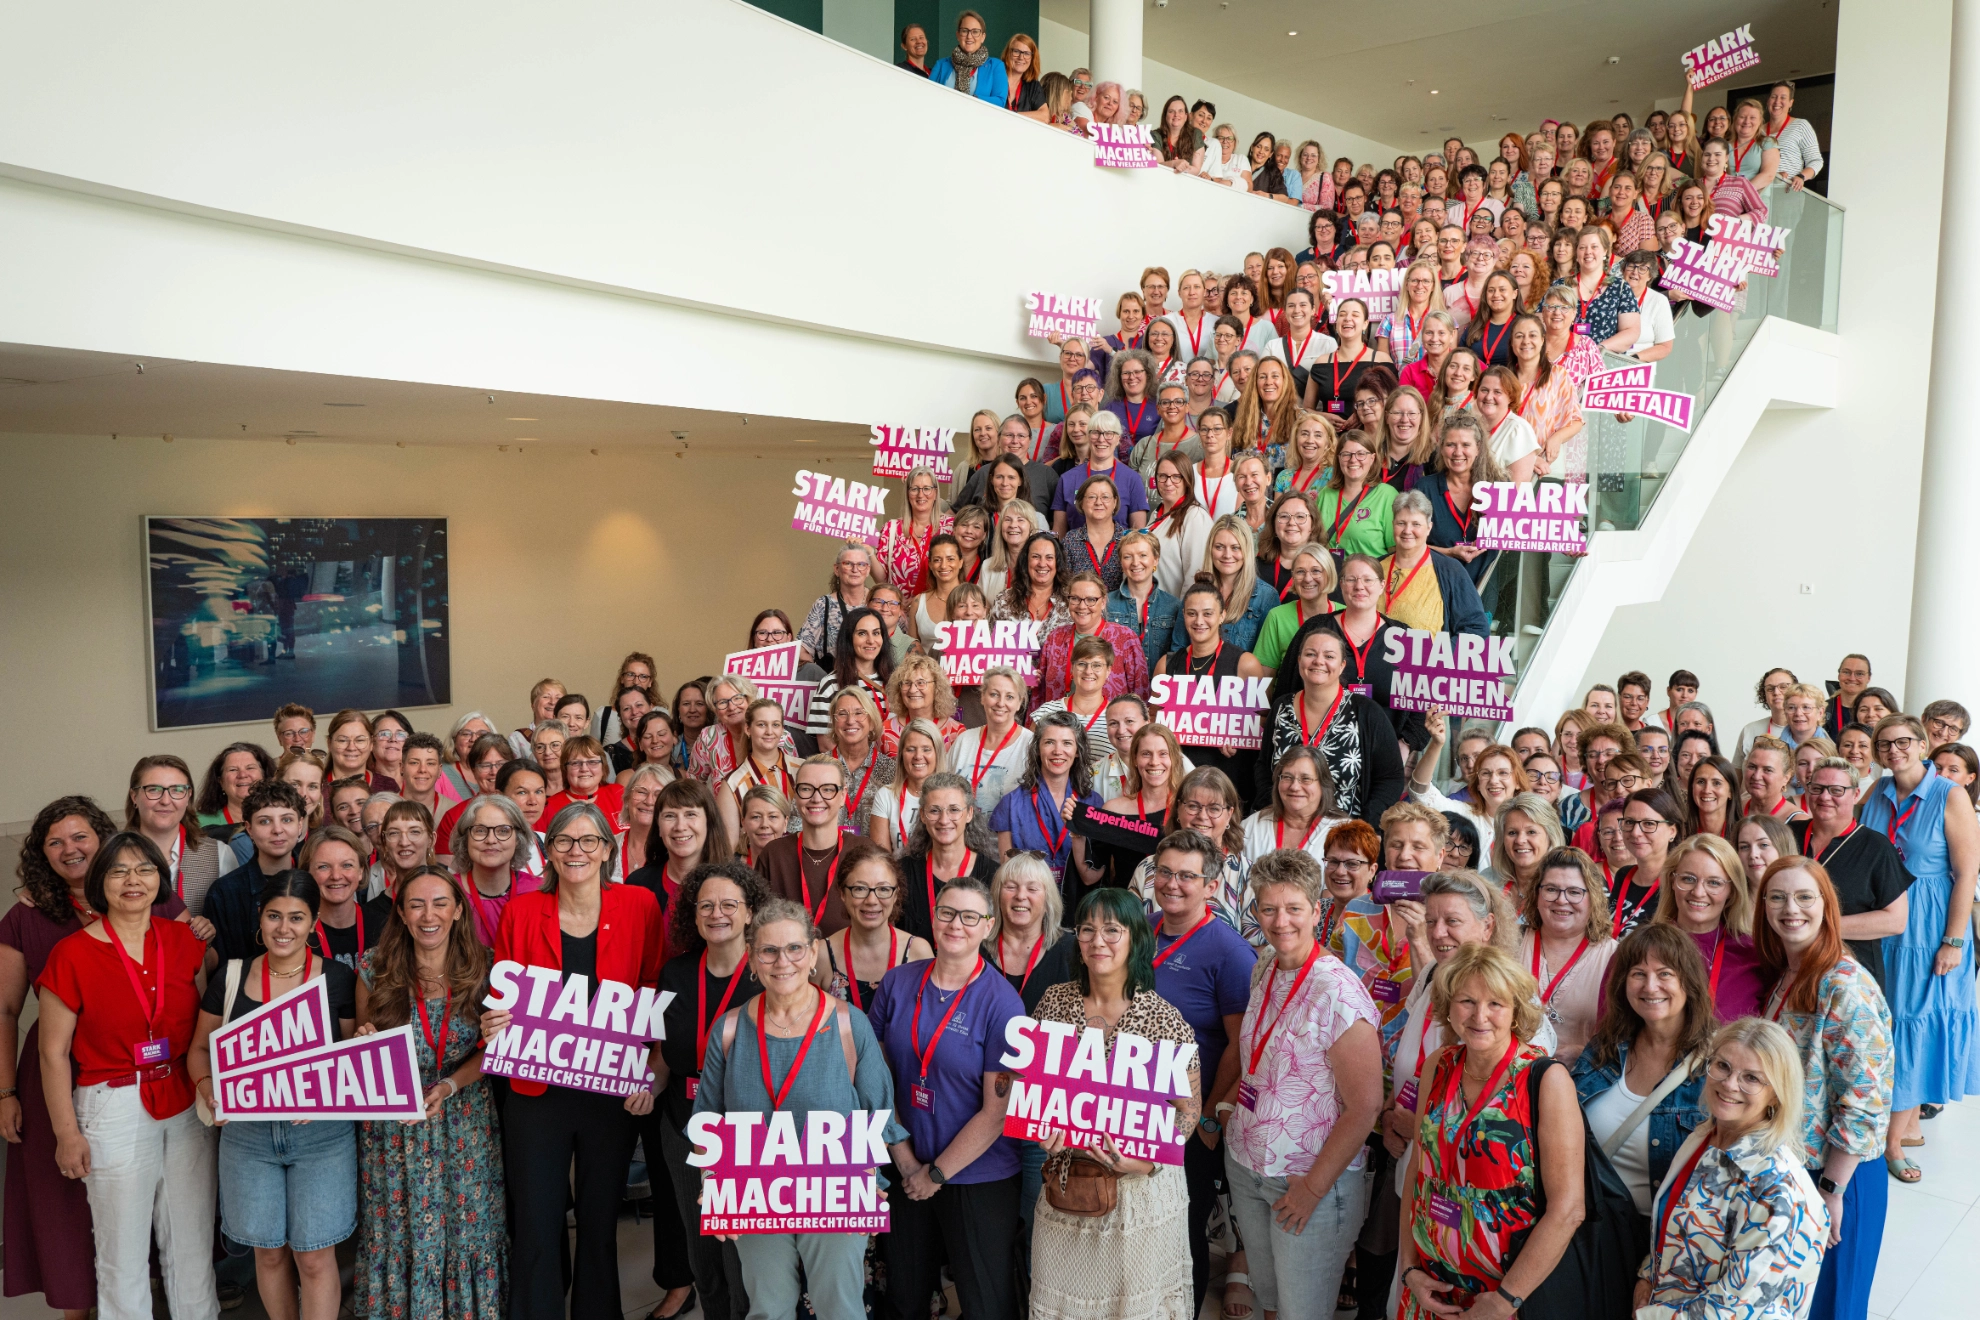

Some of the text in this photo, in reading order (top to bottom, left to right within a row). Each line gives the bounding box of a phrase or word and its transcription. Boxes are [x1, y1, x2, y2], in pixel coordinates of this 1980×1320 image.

[1681, 23, 1755, 72] STARK
[1691, 46, 1759, 85] MACHEN.
[1693, 58, 1760, 91] FÜR GLEICHSTELLUNG
[1086, 121, 1155, 145] STARK
[1095, 145, 1157, 161] MACHEN.
[1103, 159, 1116, 167] FÜR
[1705, 213, 1792, 252] STARK
[1667, 237, 1752, 284] STARK
[1322, 268, 1408, 294] STARK
[1662, 264, 1736, 306] MACHEN.
[1671, 283, 1733, 311] ENTGELTGERECHTIGKEIT
[1025, 290, 1103, 320] STARK
[1029, 314, 1101, 337] MACHEN.
[1029, 328, 1043, 337] FÜR
[1592, 369, 1645, 389] TEAM
[1588, 392, 1684, 424] IG METALL
[869, 421, 957, 453] STARK
[873, 450, 953, 474] MACHEN.
[792, 469, 890, 514] STARK
[1470, 481, 1590, 514] STARK
[793, 501, 880, 537] MACHEN.
[803, 522, 822, 533] FÜR
[1477, 517, 1586, 542] MACHEN.
[1480, 538, 1581, 552] FÜR VEREINBARKEIT
[932, 619, 1042, 650] STARK
[1383, 626, 1517, 674] STARK
[731, 651, 788, 676] TEAM
[949, 674, 969, 684] FÜR
[1148, 674, 1273, 709] STARK
[1390, 670, 1514, 708] MACHEN.
[1394, 696, 1414, 709] FÜR
[1179, 734, 1262, 748] VEREINBARKEIT
[1085, 806, 1158, 837] Superheldin
[482, 960, 677, 1040] STARK
[220, 999, 317, 1066] TEAM
[485, 1024, 656, 1082] MACHEN.
[999, 1015, 1199, 1098] STARK
[226, 1045, 408, 1109] IG METALL
[483, 1055, 650, 1096] FÜR GLEICHSTELLUNG
[1006, 1080, 1186, 1146] MACHEN.
[686, 1109, 892, 1167] STARK
[1071, 1130, 1159, 1160] VIELFALT
[701, 1176, 890, 1214] MACHEN.
[704, 1216, 886, 1230] FÜR ENTGELTGERECHTIGKEIT
